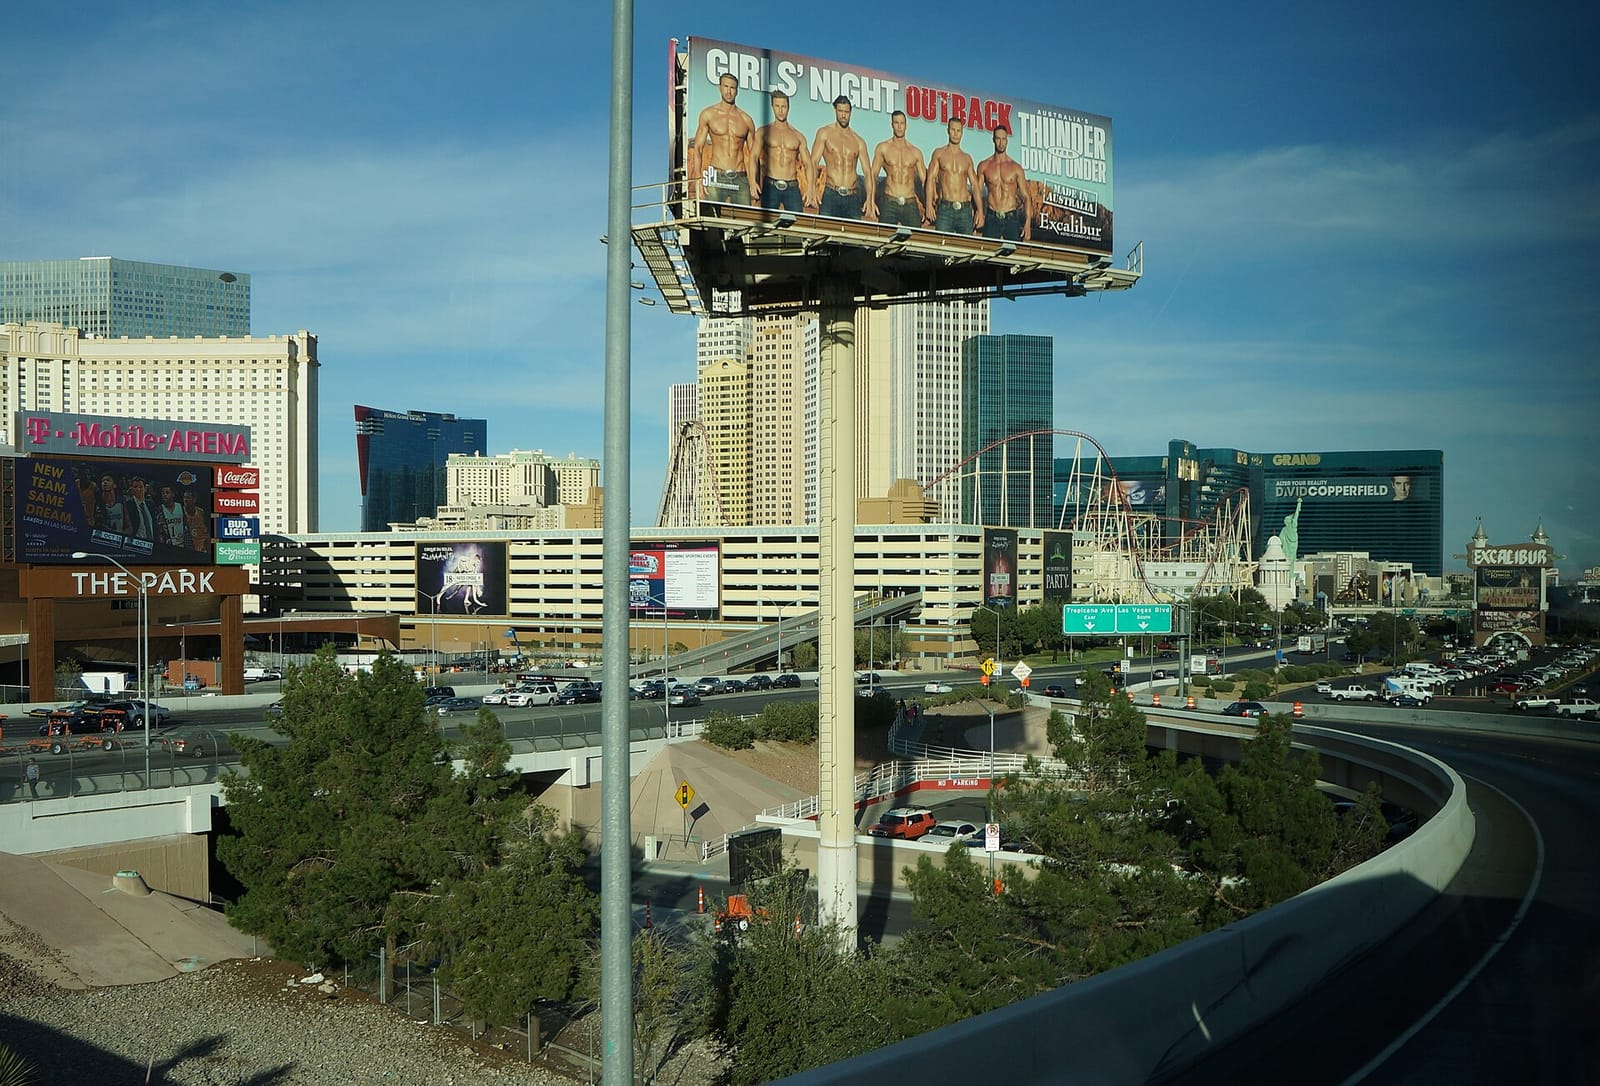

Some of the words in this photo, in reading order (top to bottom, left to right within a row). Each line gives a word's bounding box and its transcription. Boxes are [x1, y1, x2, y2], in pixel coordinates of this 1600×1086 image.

[706, 48, 804, 97] GIRLS'
[810, 66, 900, 114] NIGHT
[905, 85, 1014, 136] OUTBACK
[1037, 109, 1089, 125] AUSTRALIA'S
[1018, 111, 1106, 160] THUNDER
[1021, 145, 1062, 177] DOWN
[1065, 157, 1107, 184] UNDER
[1053, 184, 1077, 199] MADE
[1080, 191, 1089, 201] IN
[1046, 192, 1094, 213] AUSTRALIA
[1039, 212, 1102, 237] Excalibur
[167, 429, 249, 455] ARENA
[1272, 454, 1321, 466] GRAND
[34, 462, 65, 479] NEW
[28, 489, 65, 508] SAME
[218, 498, 257, 508] TOSHIBA
[224, 527, 252, 537] LIGHT
[227, 520, 248, 528] BUD
[218, 547, 258, 556] Schneider
[1472, 549, 1548, 565] EXCALIBUR
[71, 572, 128, 595] THE
[141, 571, 215, 594] PARK
